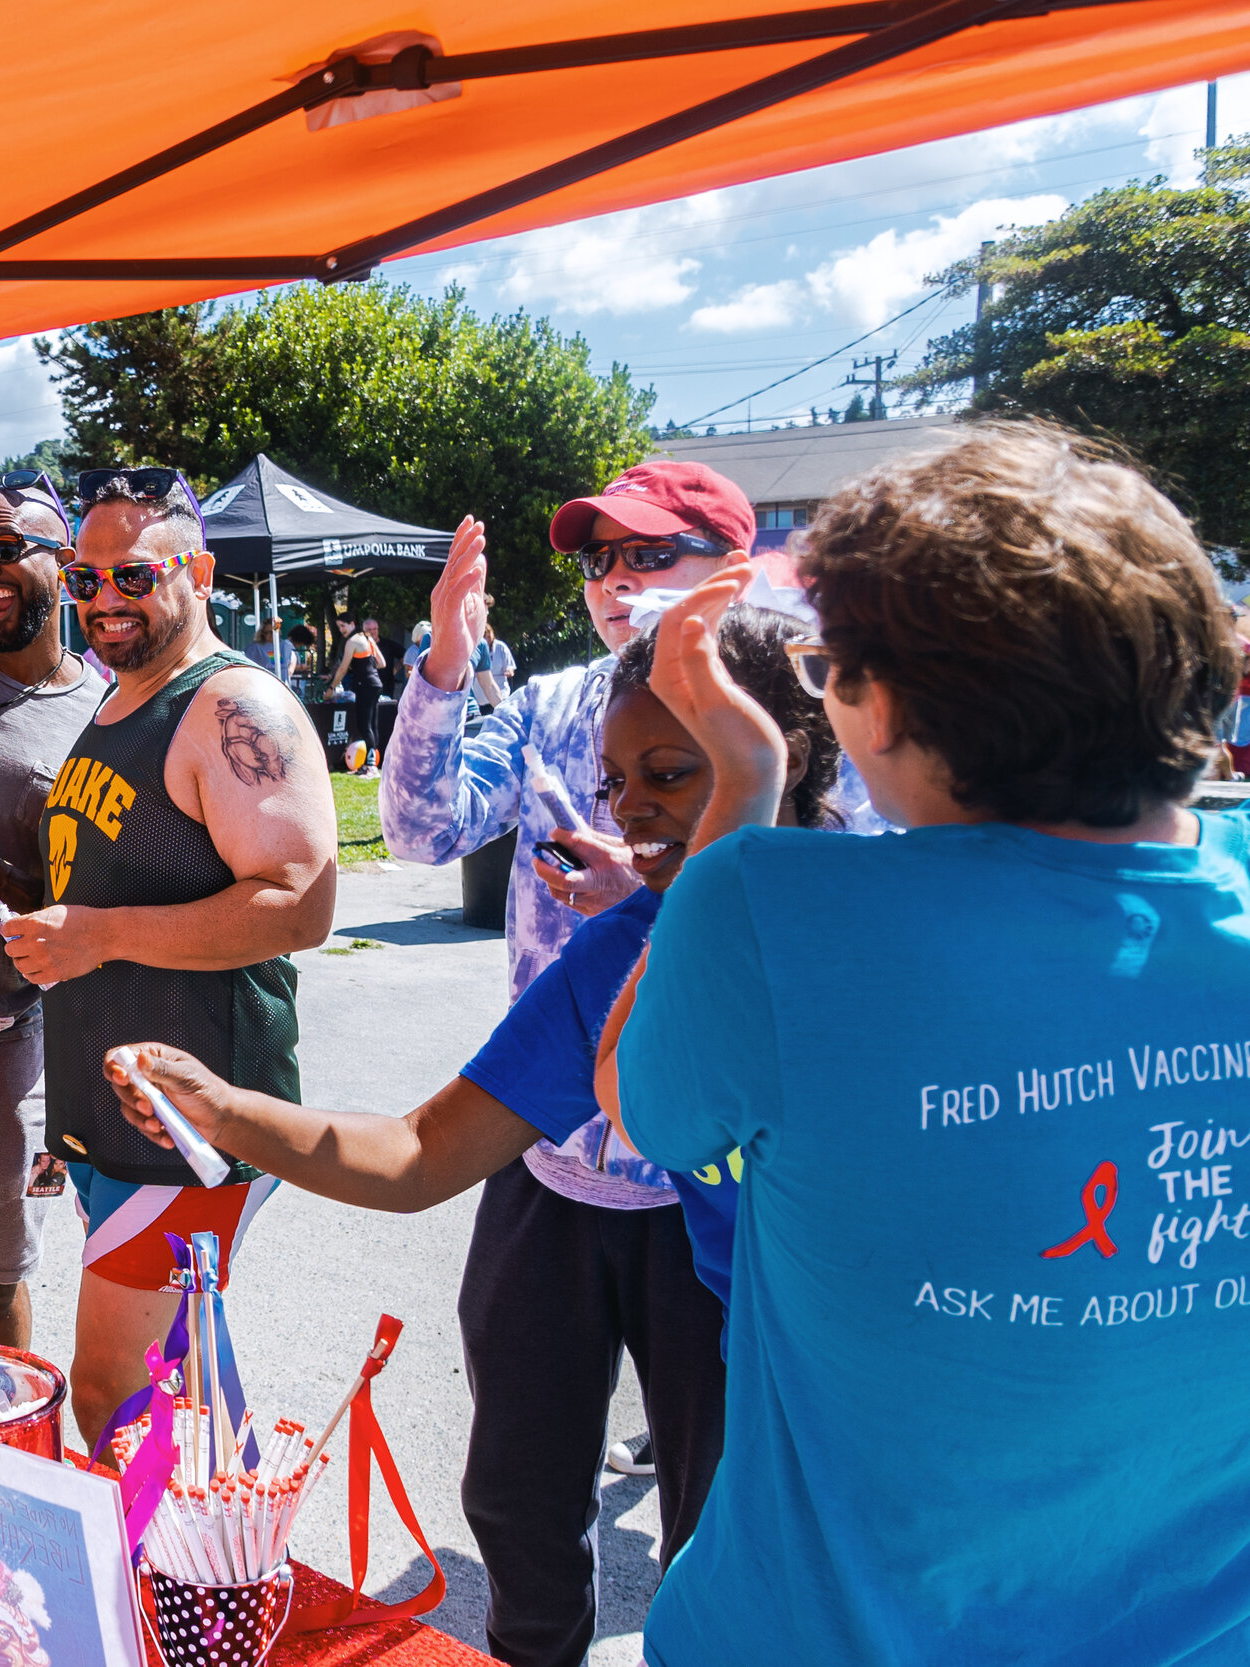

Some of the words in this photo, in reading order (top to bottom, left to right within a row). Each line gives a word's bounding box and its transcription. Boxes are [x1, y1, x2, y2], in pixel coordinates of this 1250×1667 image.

[343, 543, 396, 557] UMPQUA
[397, 544, 426, 557] BANK
[39, 757, 137, 842] UAKE
[919, 1083, 1001, 1130] FRED
[1017, 1060, 1115, 1114] HUTCH
[1147, 1119, 1250, 1169] Join
[1158, 1165, 1234, 1203] THE
[1147, 1199, 1250, 1269] fight
[914, 1281, 995, 1321] ASK
[1009, 1294, 1064, 1326] ME
[1080, 1283, 1200, 1326] ABOUT
